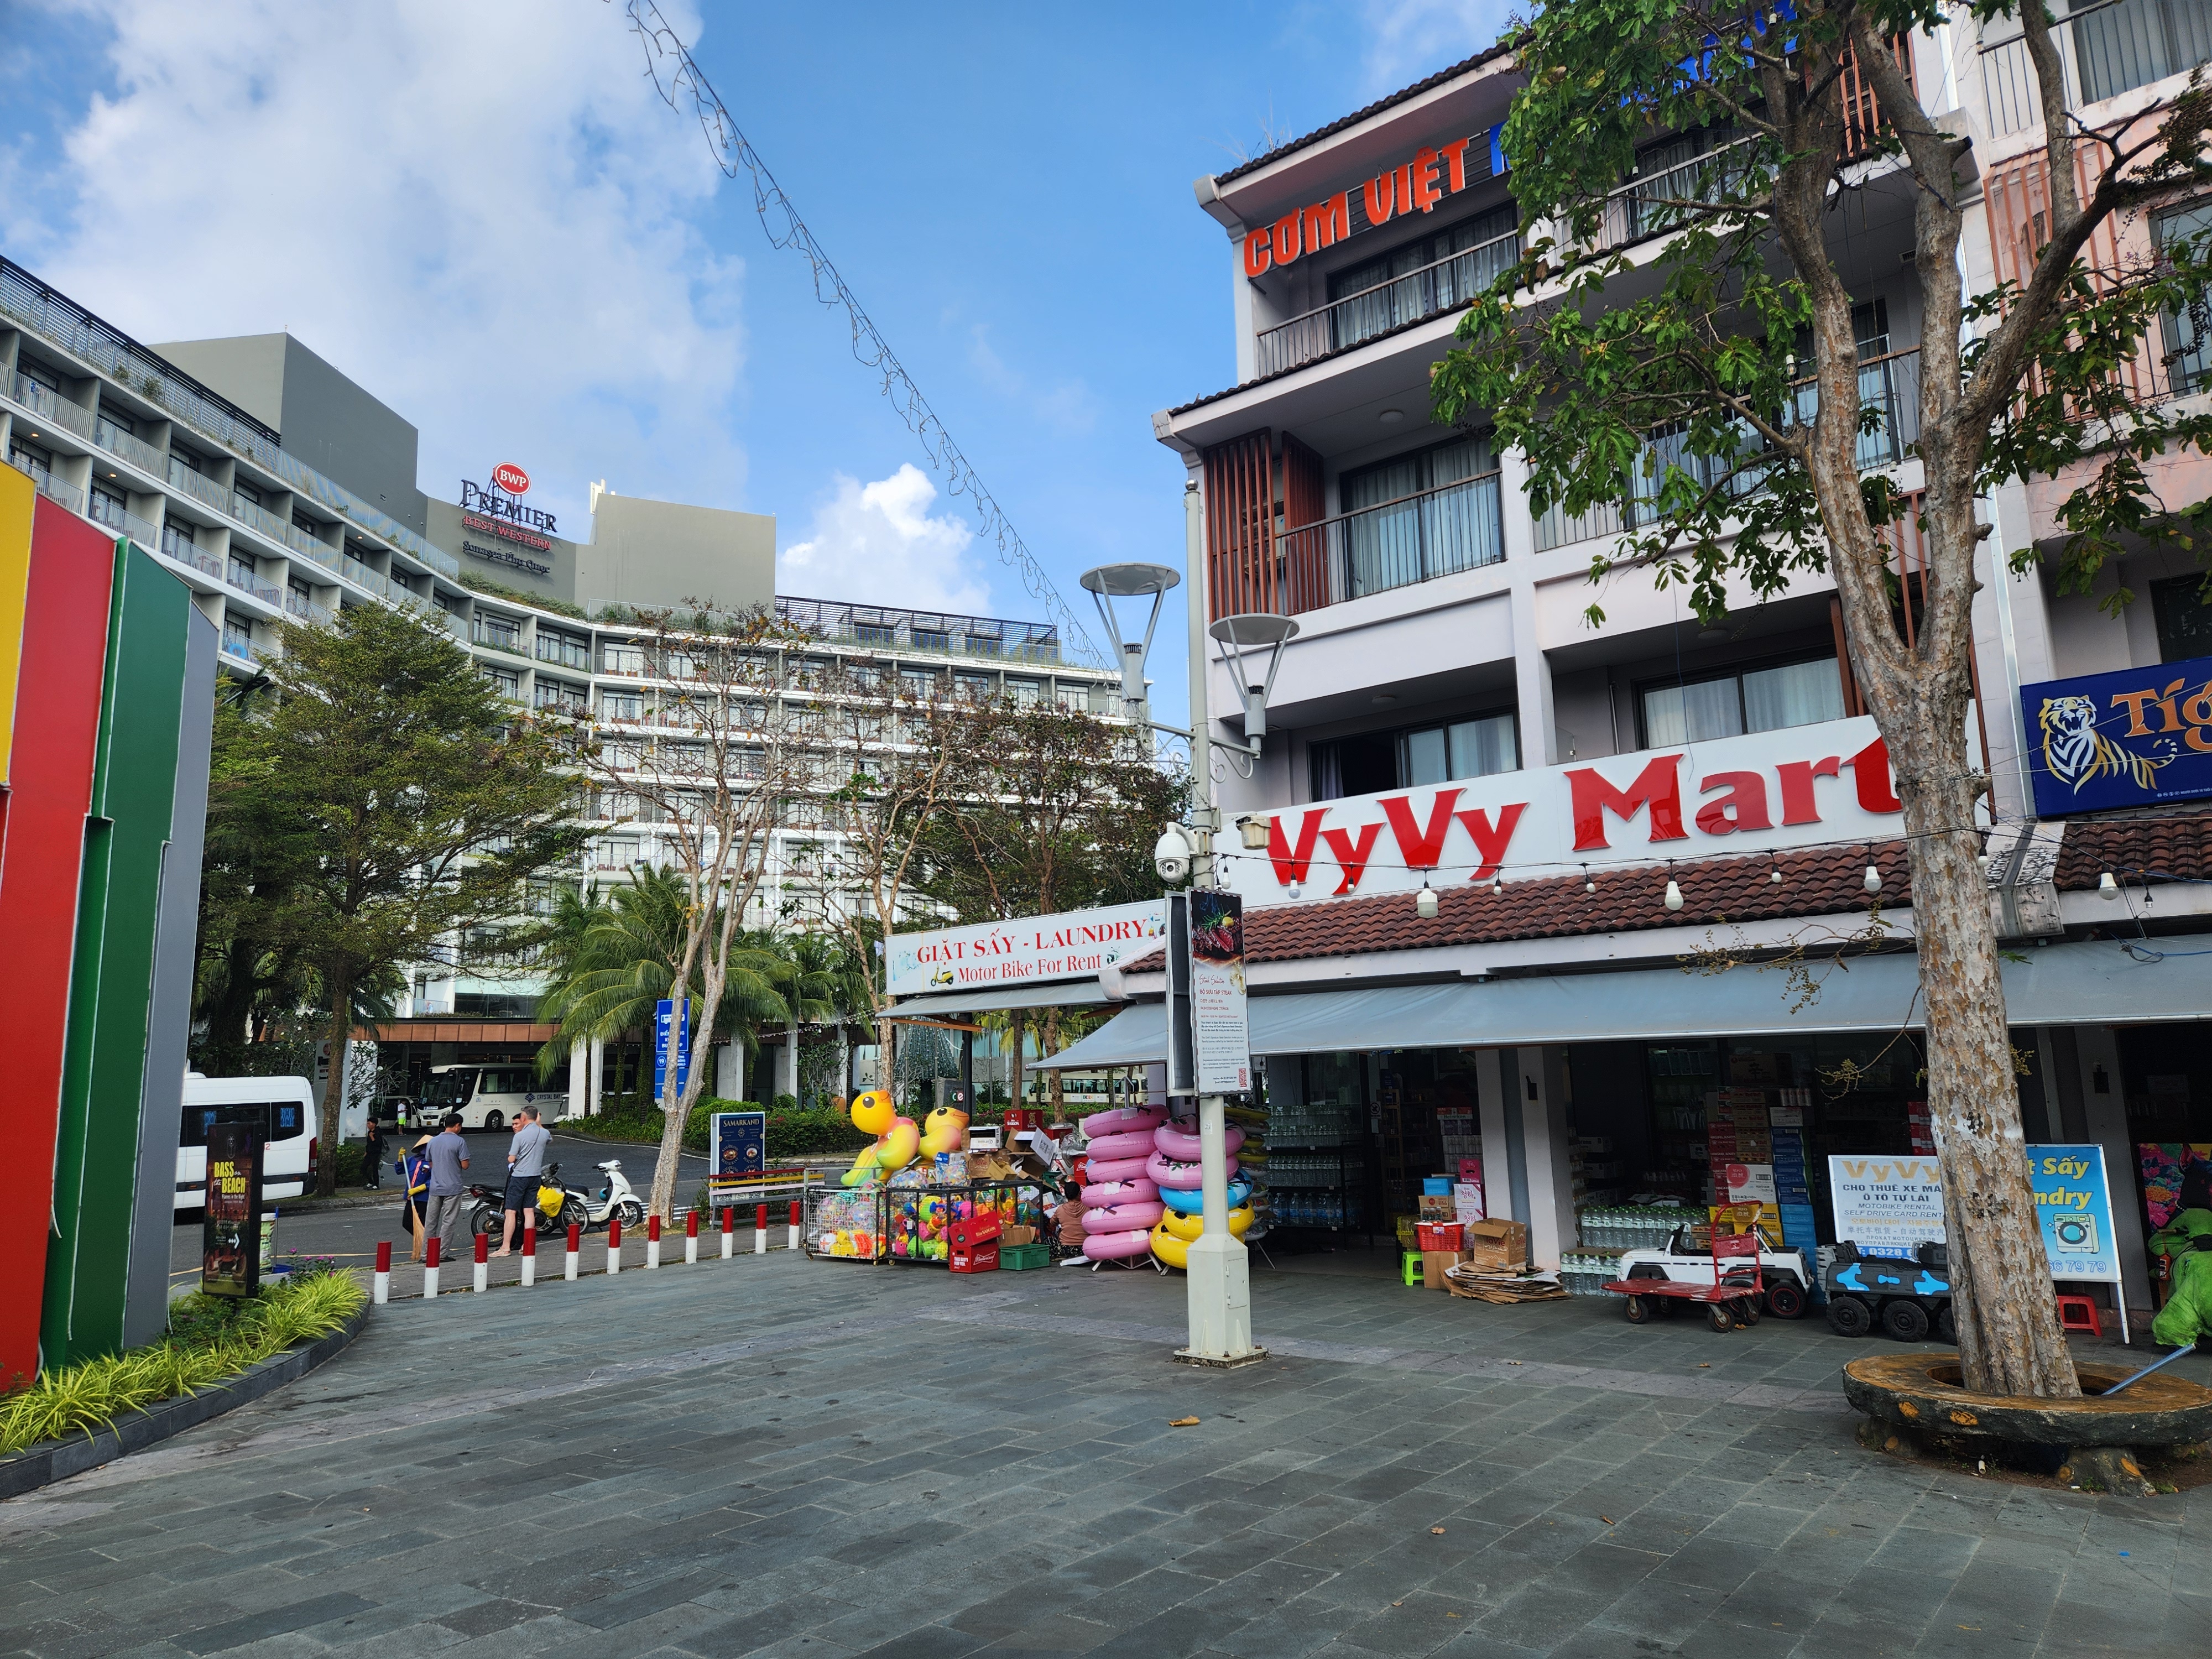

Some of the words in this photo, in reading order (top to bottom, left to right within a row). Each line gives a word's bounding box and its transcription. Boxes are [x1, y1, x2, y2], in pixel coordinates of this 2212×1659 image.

[1243, 190, 1351, 278] CƠM
[1363, 137, 1469, 227] VIỆT
[500, 469, 526, 487] BWP
[461, 479, 557, 533] PREMIER
[464, 516, 494, 533] BEST
[497, 526, 551, 550] WESTERN
[1268, 787, 1530, 895] VyVy
[1563, 735, 1905, 852] Mart
[917, 939, 967, 966] GIẶT
[973, 928, 1016, 958] SẤY
[1035, 918, 1148, 951] LAUNDRY
[958, 966, 997, 983] Motor
[1002, 959, 1034, 978] Bike
[1038, 958, 1062, 975] For
[1067, 952, 1101, 972] Rent
[723, 1119, 759, 1128] SAMARKAND
[214, 1161, 234, 1177] BASS
[1841, 1161, 1940, 1184] VyVy
[2042, 1155, 2090, 1180] Sấy
[222, 1177, 246, 1193] BEACH
[1870, 1183, 1898, 1192] THUÊ
[1874, 1193, 1888, 1201] TÔ
[1892, 1194, 1908, 1203] TỰ
[1911, 1194, 1929, 1202] LÁI
[1847, 1226, 1891, 1235] 摩托车租赁
[1869, 1248, 1902, 1256] 0328
[2066, 1260, 2084, 1272] 79
[2088, 1261, 2106, 1273] 79
